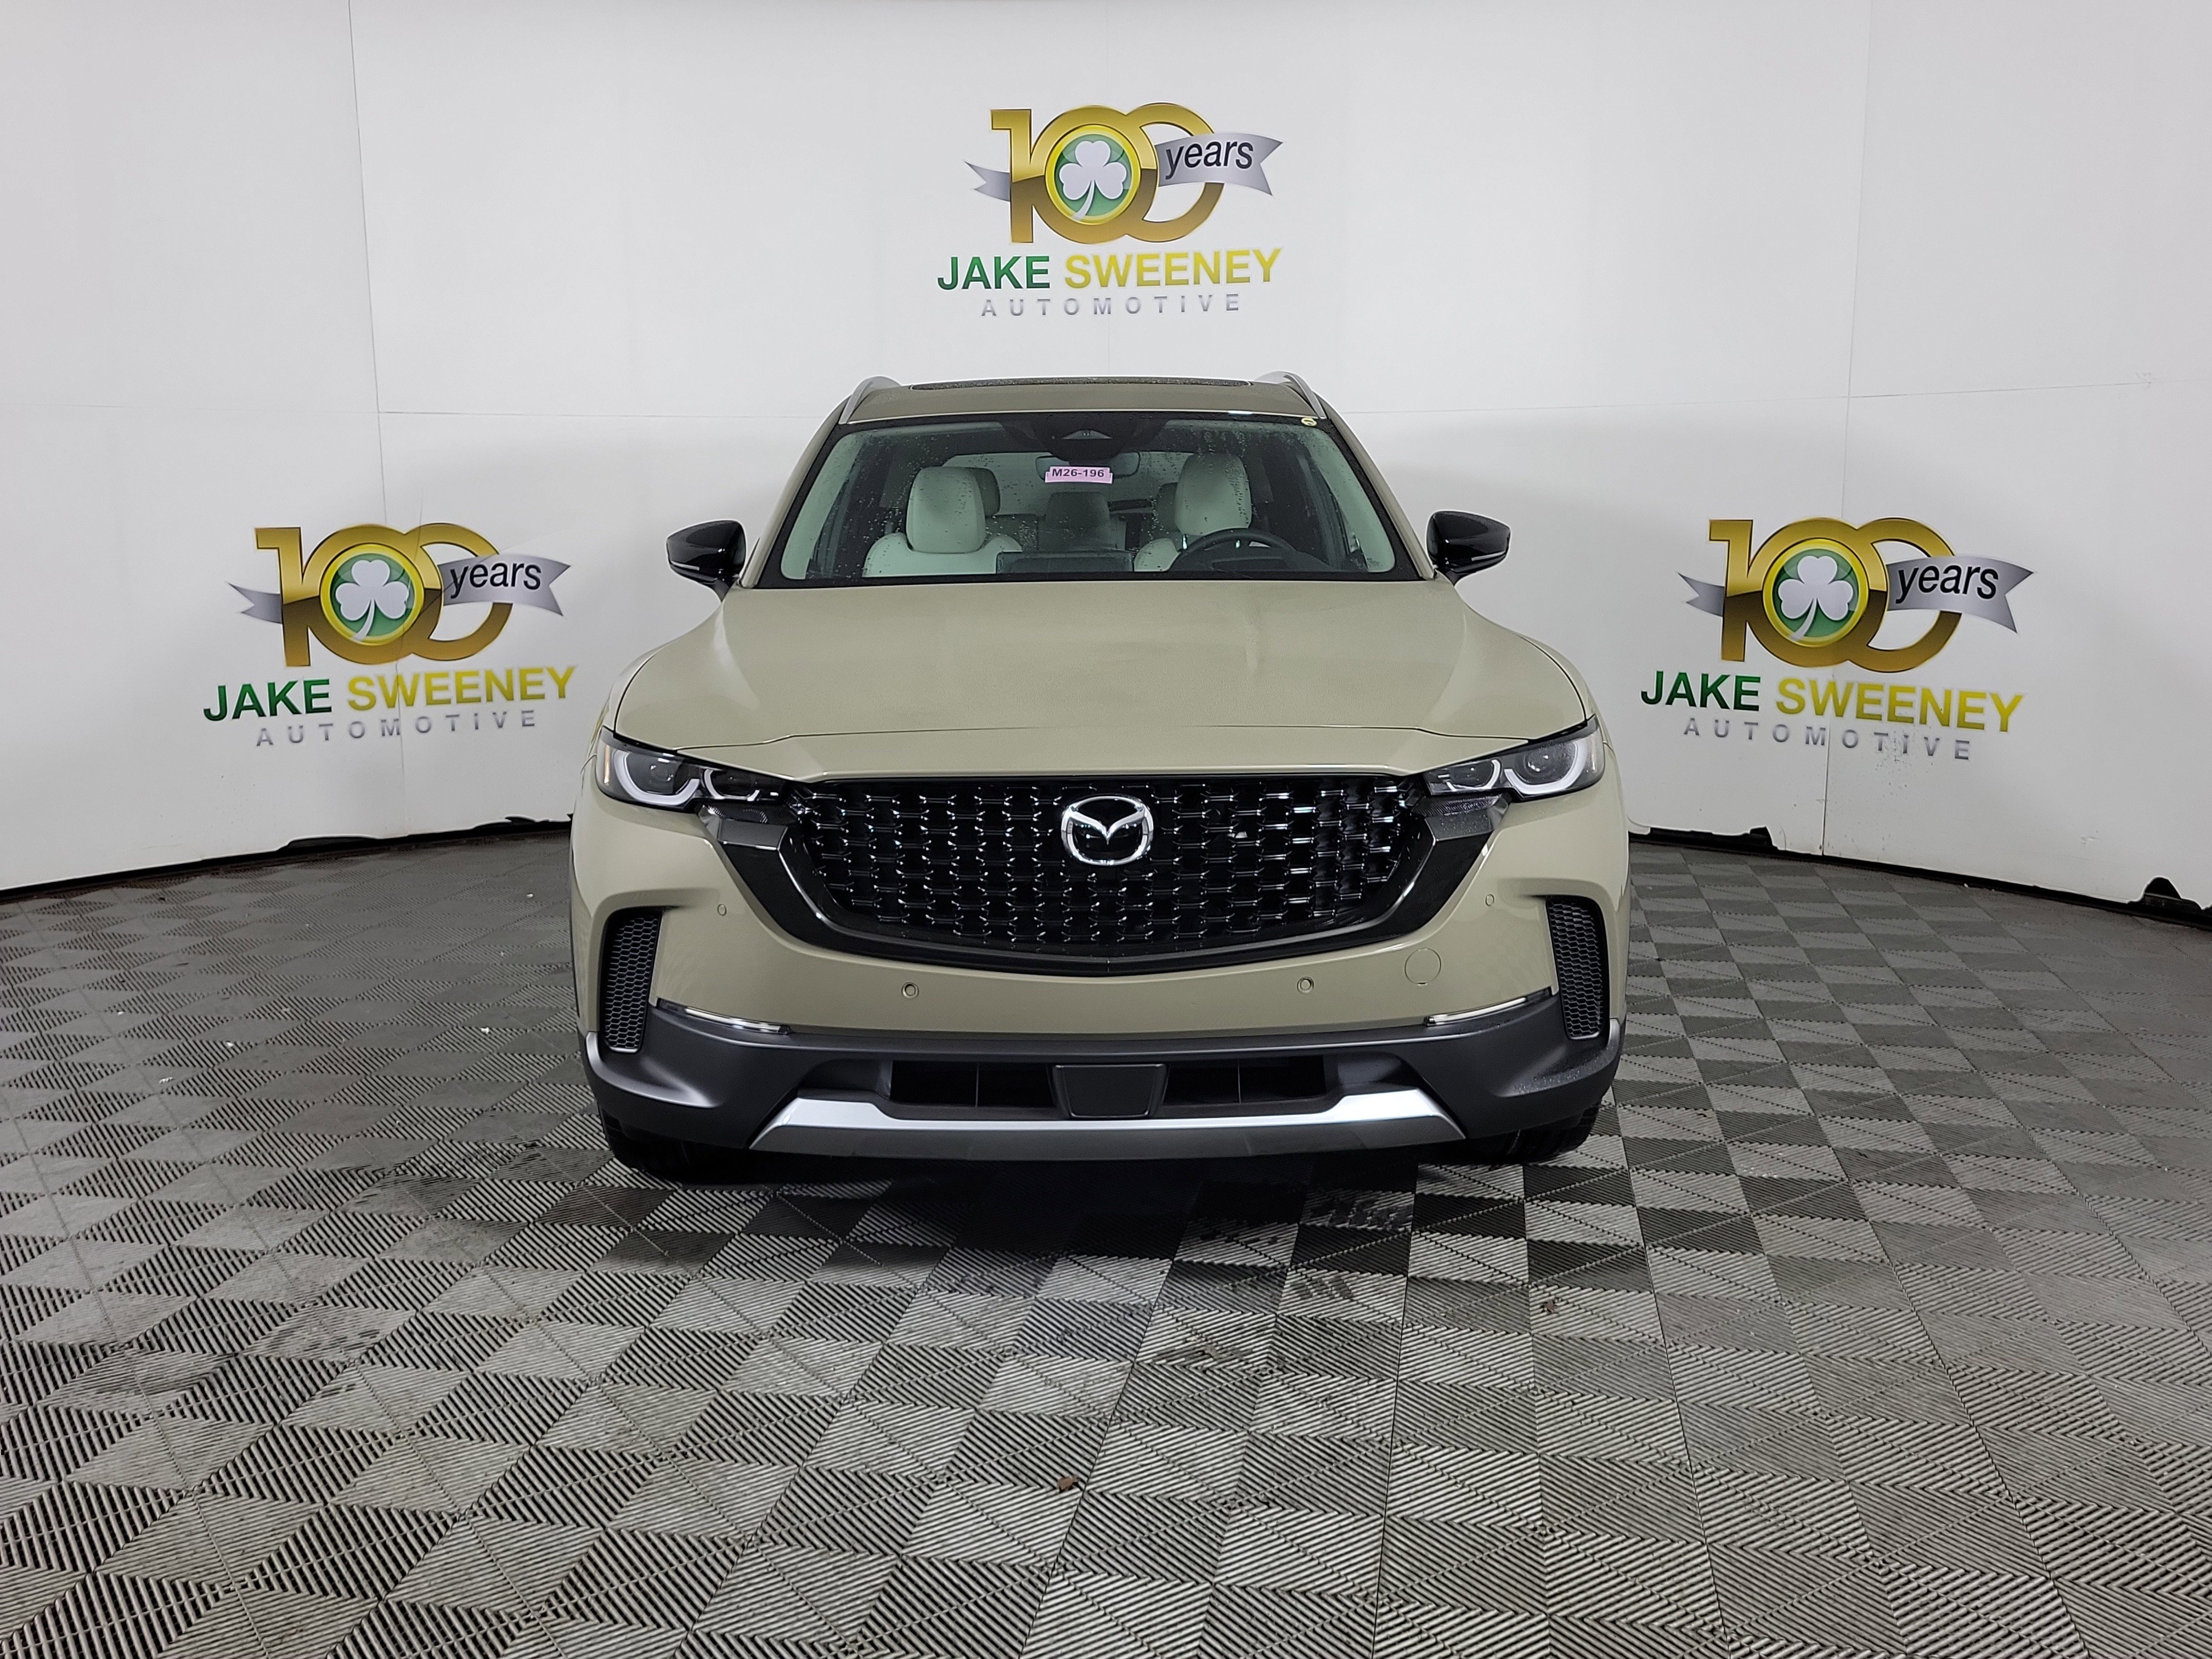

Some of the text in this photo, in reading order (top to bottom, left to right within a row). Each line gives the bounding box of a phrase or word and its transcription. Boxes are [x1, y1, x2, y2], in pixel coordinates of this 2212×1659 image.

[990, 102, 1254, 244] 100 years
[937, 248, 1281, 290] JAKE SWEENEY
[981, 294, 1239, 317] AUTOMOTIVE
[1052, 469, 1104, 477] M26-196
[254, 523, 541, 667] 100 years
[1708, 517, 1999, 673] 100 years
[203, 665, 576, 721] JAKE SWEENEY
[1640, 670, 2024, 733] JAKE SWEENEY
[256, 710, 535, 747] AUTOMOTIVE
[1683, 718, 1970, 760] AUTOMOTIVE
